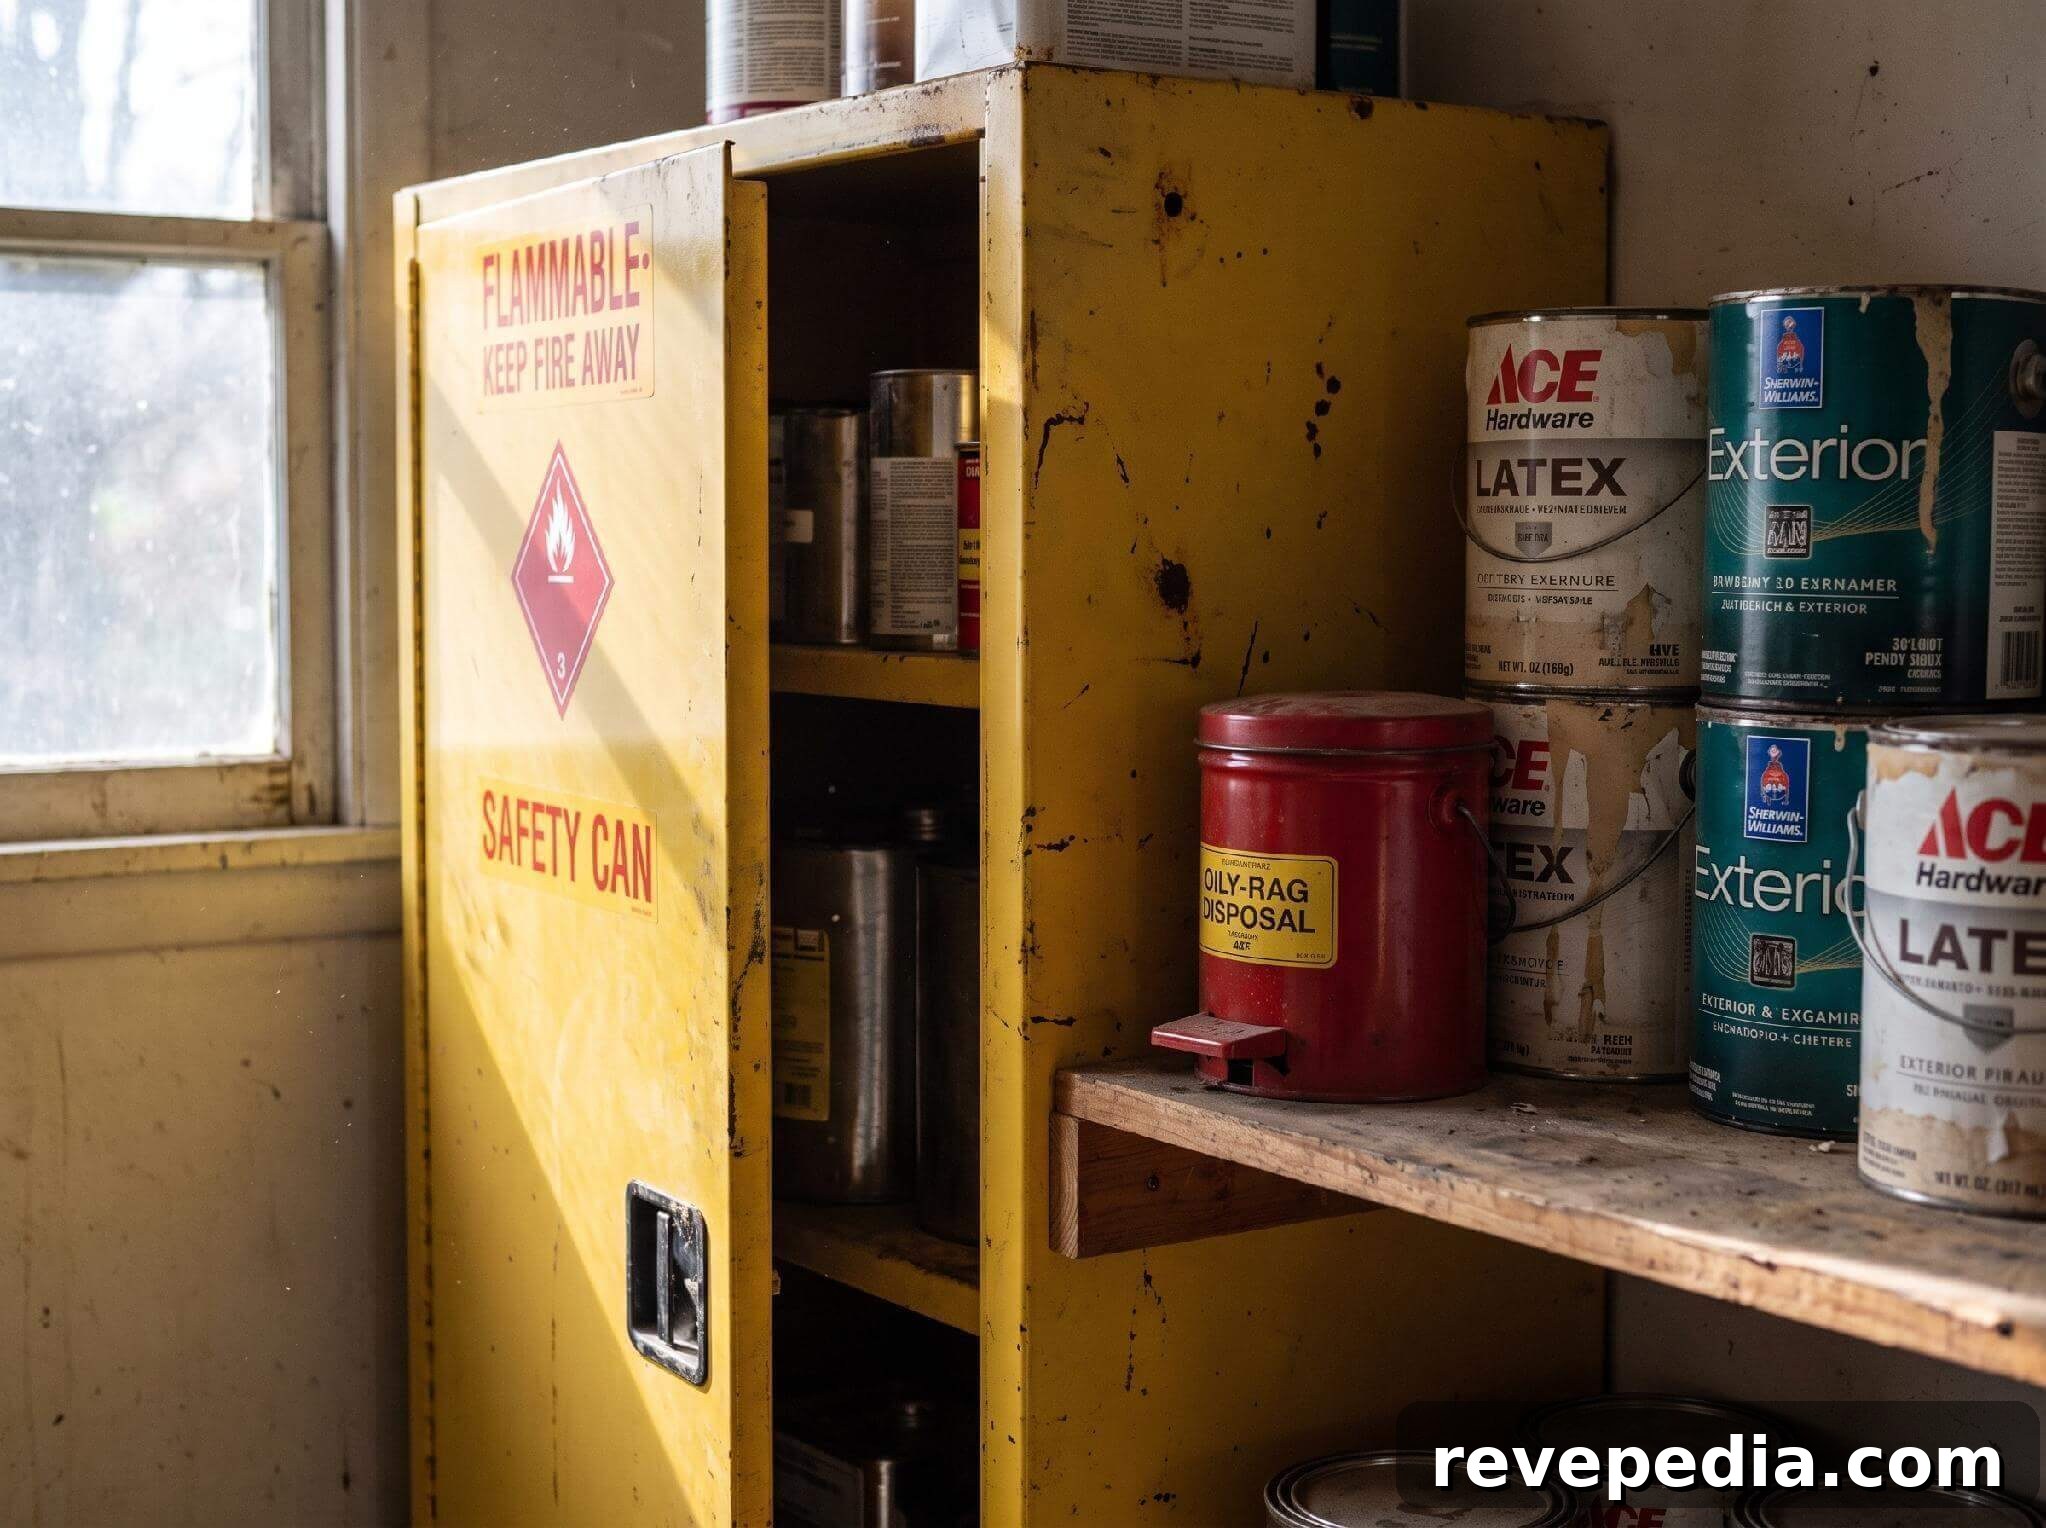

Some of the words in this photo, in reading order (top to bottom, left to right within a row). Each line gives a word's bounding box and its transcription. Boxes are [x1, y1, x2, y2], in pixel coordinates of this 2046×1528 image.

[483, 341, 528, 396] KEEP
[534, 332, 576, 391] FIRE
[582, 323, 640, 386] AWAY
[1486, 343, 1603, 405] ACE
[1763, 377, 1819, 390] SHERWIN-
[1486, 408, 1595, 431] Hardware
[1708, 424, 1929, 481] Exterior
[1476, 457, 1628, 497] LATEX
[1799, 602, 1868, 614] EXTERIOR
[557, 652, 566, 679] 3
[1489, 735, 1551, 791] CE
[1490, 798, 1547, 816] ware
[1747, 806, 1805, 823] SHERWIN-
[482, 789, 582, 883] SAFETY
[591, 813, 653, 904] CAN
[1494, 841, 1575, 884] EX
[1204, 867, 1310, 903] OILY-RAG
[1916, 861, 2046, 896] Hardwar
[1202, 896, 1316, 934] DISPOSAL
[1899, 917, 2046, 977] LATE
[1702, 993, 1757, 1017] EXTERIOR
[1761, 1005, 1773, 1019] &
[1781, 1008, 1864, 1025] EXGAMIR
[1899, 1054, 1977, 1081] EXTERIOR
